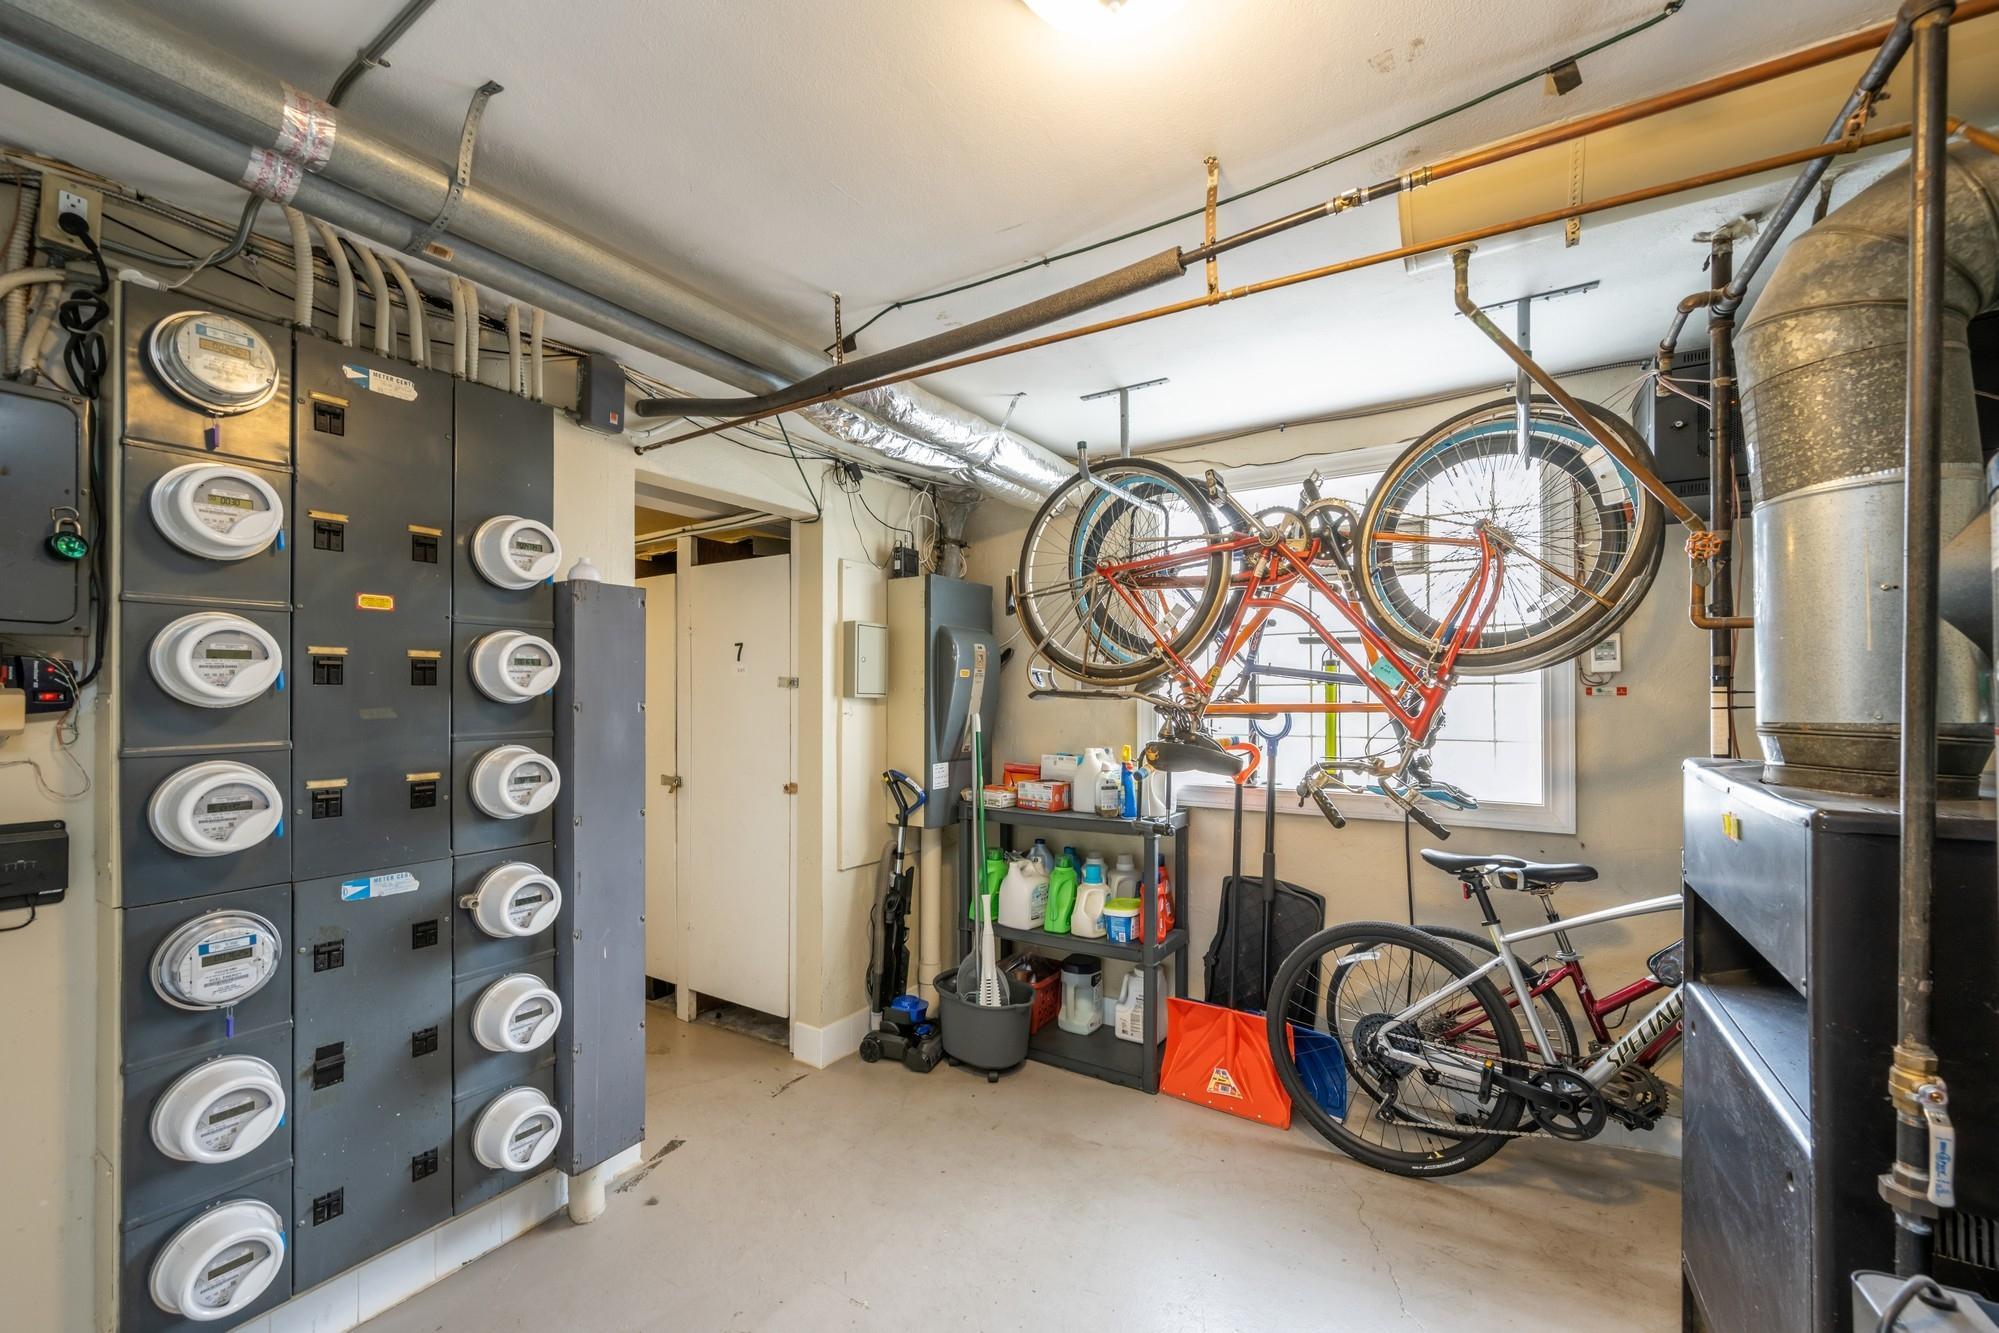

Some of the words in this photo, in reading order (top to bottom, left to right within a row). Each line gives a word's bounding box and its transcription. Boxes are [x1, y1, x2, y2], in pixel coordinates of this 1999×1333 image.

[372, 371, 394, 382] METER
[734, 642, 744, 662] 7
[373, 874, 394, 883] METER
